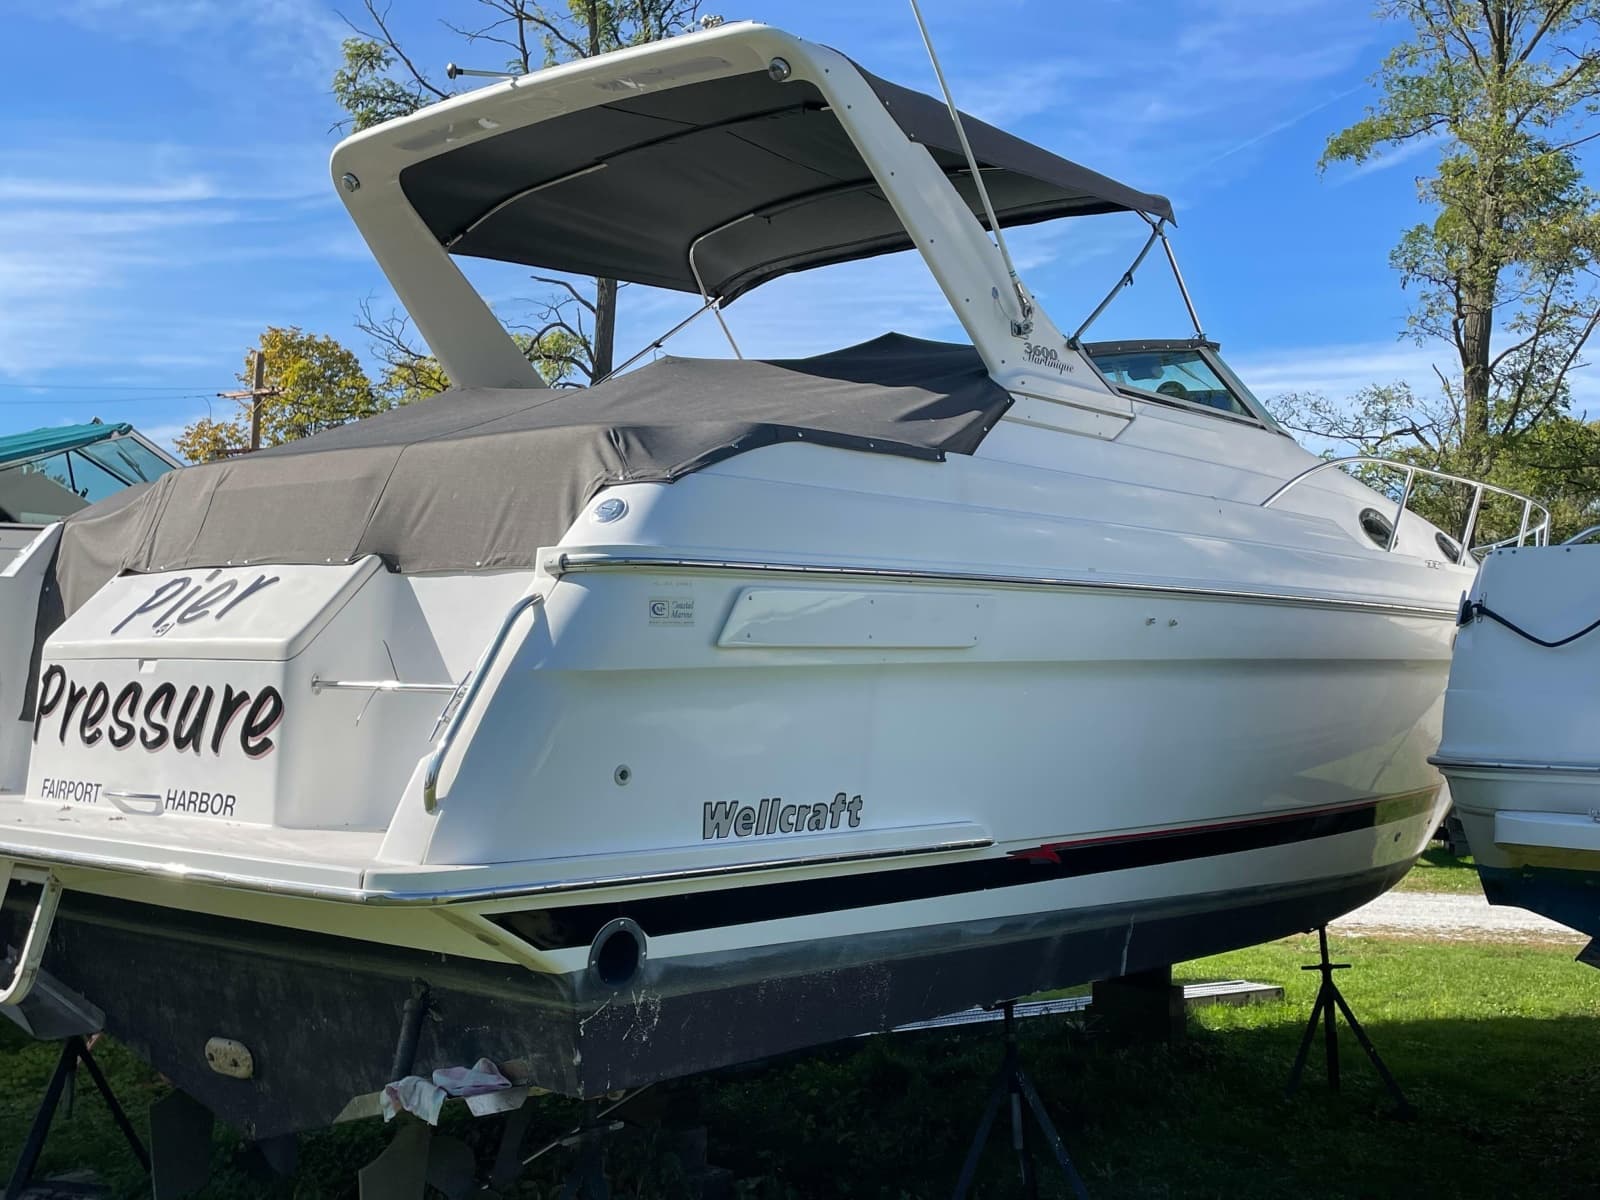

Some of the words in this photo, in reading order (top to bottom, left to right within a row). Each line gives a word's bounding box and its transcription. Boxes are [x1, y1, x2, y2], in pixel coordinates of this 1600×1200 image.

[1022, 352, 1075, 375] Martinique
[1023, 342, 1058, 361] 3600
[110, 569, 280, 635] Pier
[33, 663, 285, 759] Pressure
[41, 778, 103, 804] FAIRPORT
[164, 789, 237, 817] HARBOR
[702, 792, 864, 841] Wellcraft
